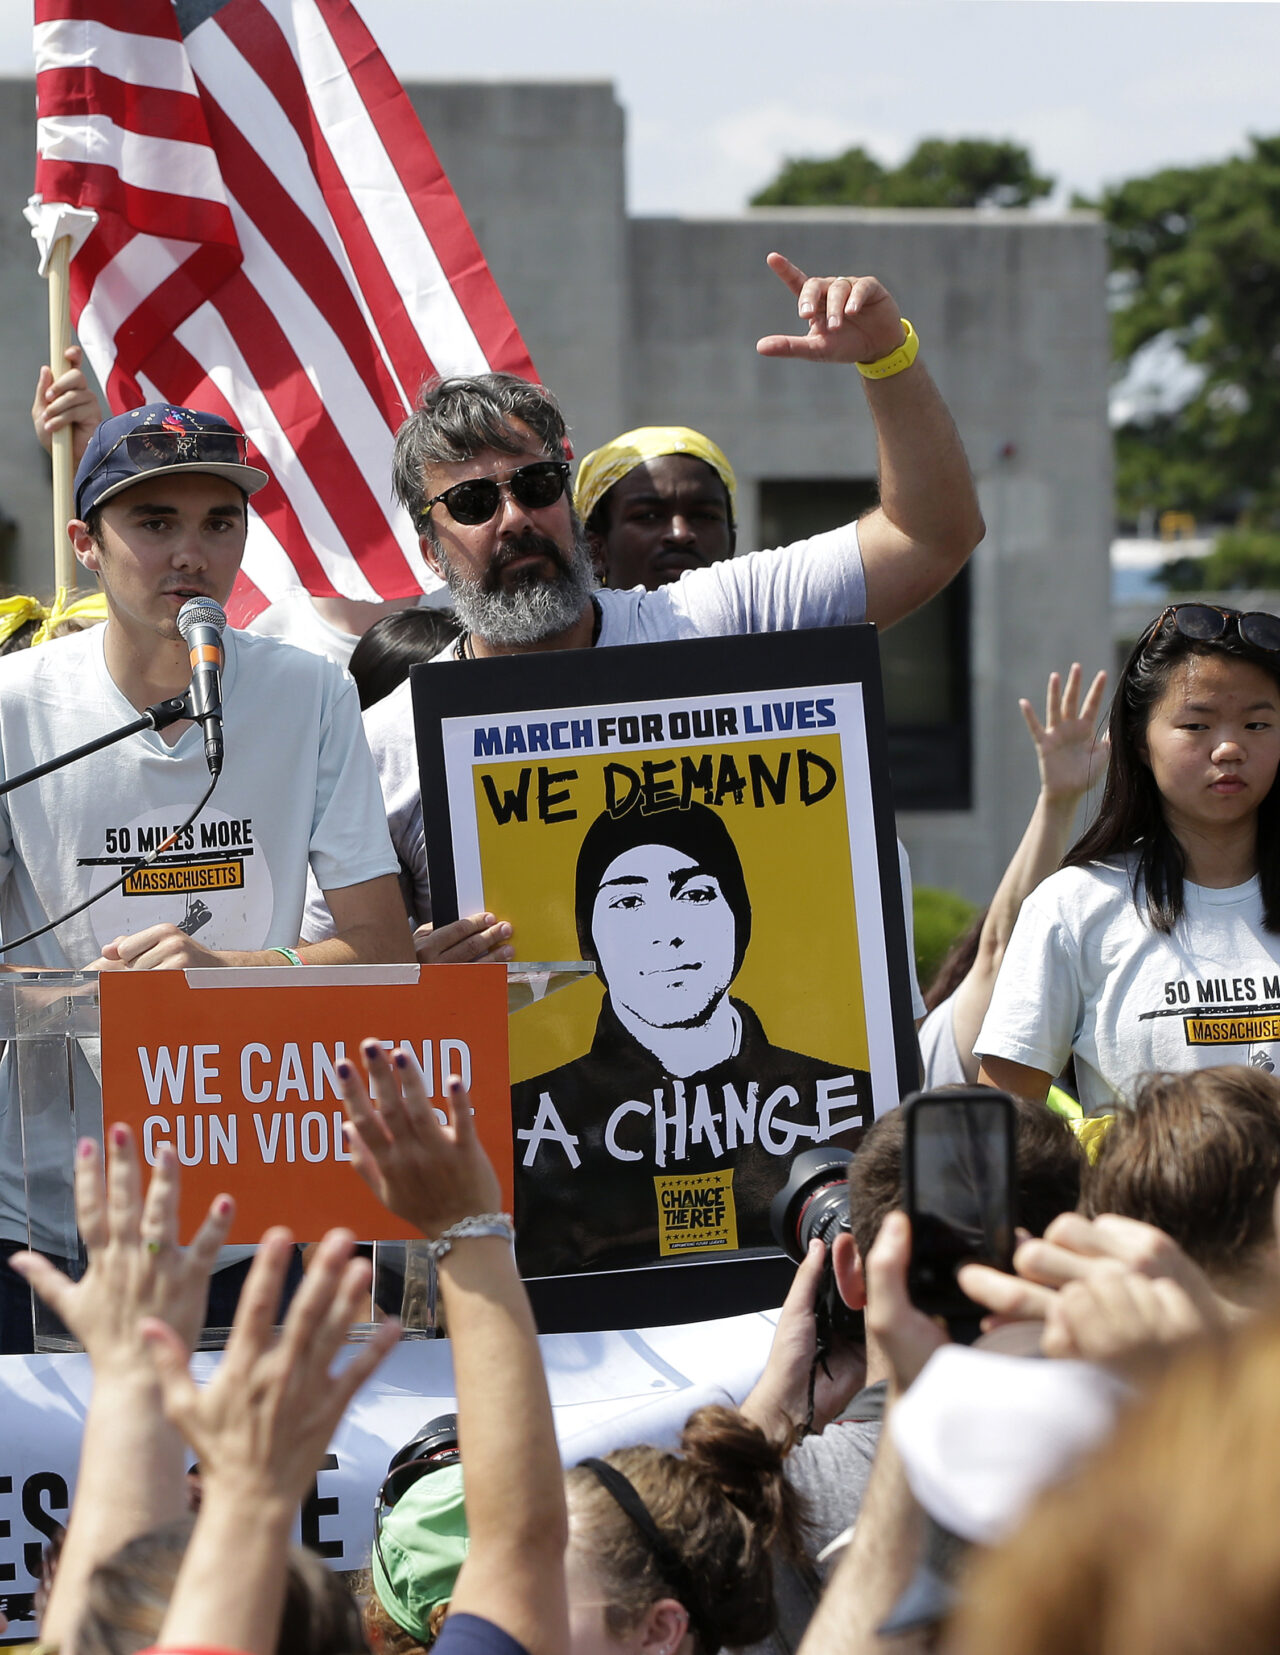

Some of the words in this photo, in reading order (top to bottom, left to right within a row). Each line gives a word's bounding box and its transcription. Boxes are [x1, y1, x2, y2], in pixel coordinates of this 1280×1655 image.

[473, 719, 593, 757] MARCH
[597, 713, 665, 747] FOR
[668, 707, 739, 740] OUR
[743, 698, 837, 734] LIVES
[481, 766, 579, 825] WE
[603, 749, 838, 820] DEMAND
[105, 828, 131, 853] 50
[137, 824, 195, 853] MILES
[200, 819, 254, 848] MORE
[130, 866, 236, 890] MASSACHUSETTS
[1164, 981, 1190, 1005] 50
[1196, 978, 1257, 1003] MILES
[1192, 1020, 1280, 1041] MASSACHUSE
[138, 1044, 222, 1105] WE
[240, 1041, 346, 1103] CAN
[517, 1092, 582, 1169] A
[605, 1075, 863, 1168] CHANGE
[143, 1113, 238, 1167] GUN
[661, 1187, 724, 1209] CHANGE
[663, 1209, 690, 1226] THE
[689, 1206, 726, 1229] REF
